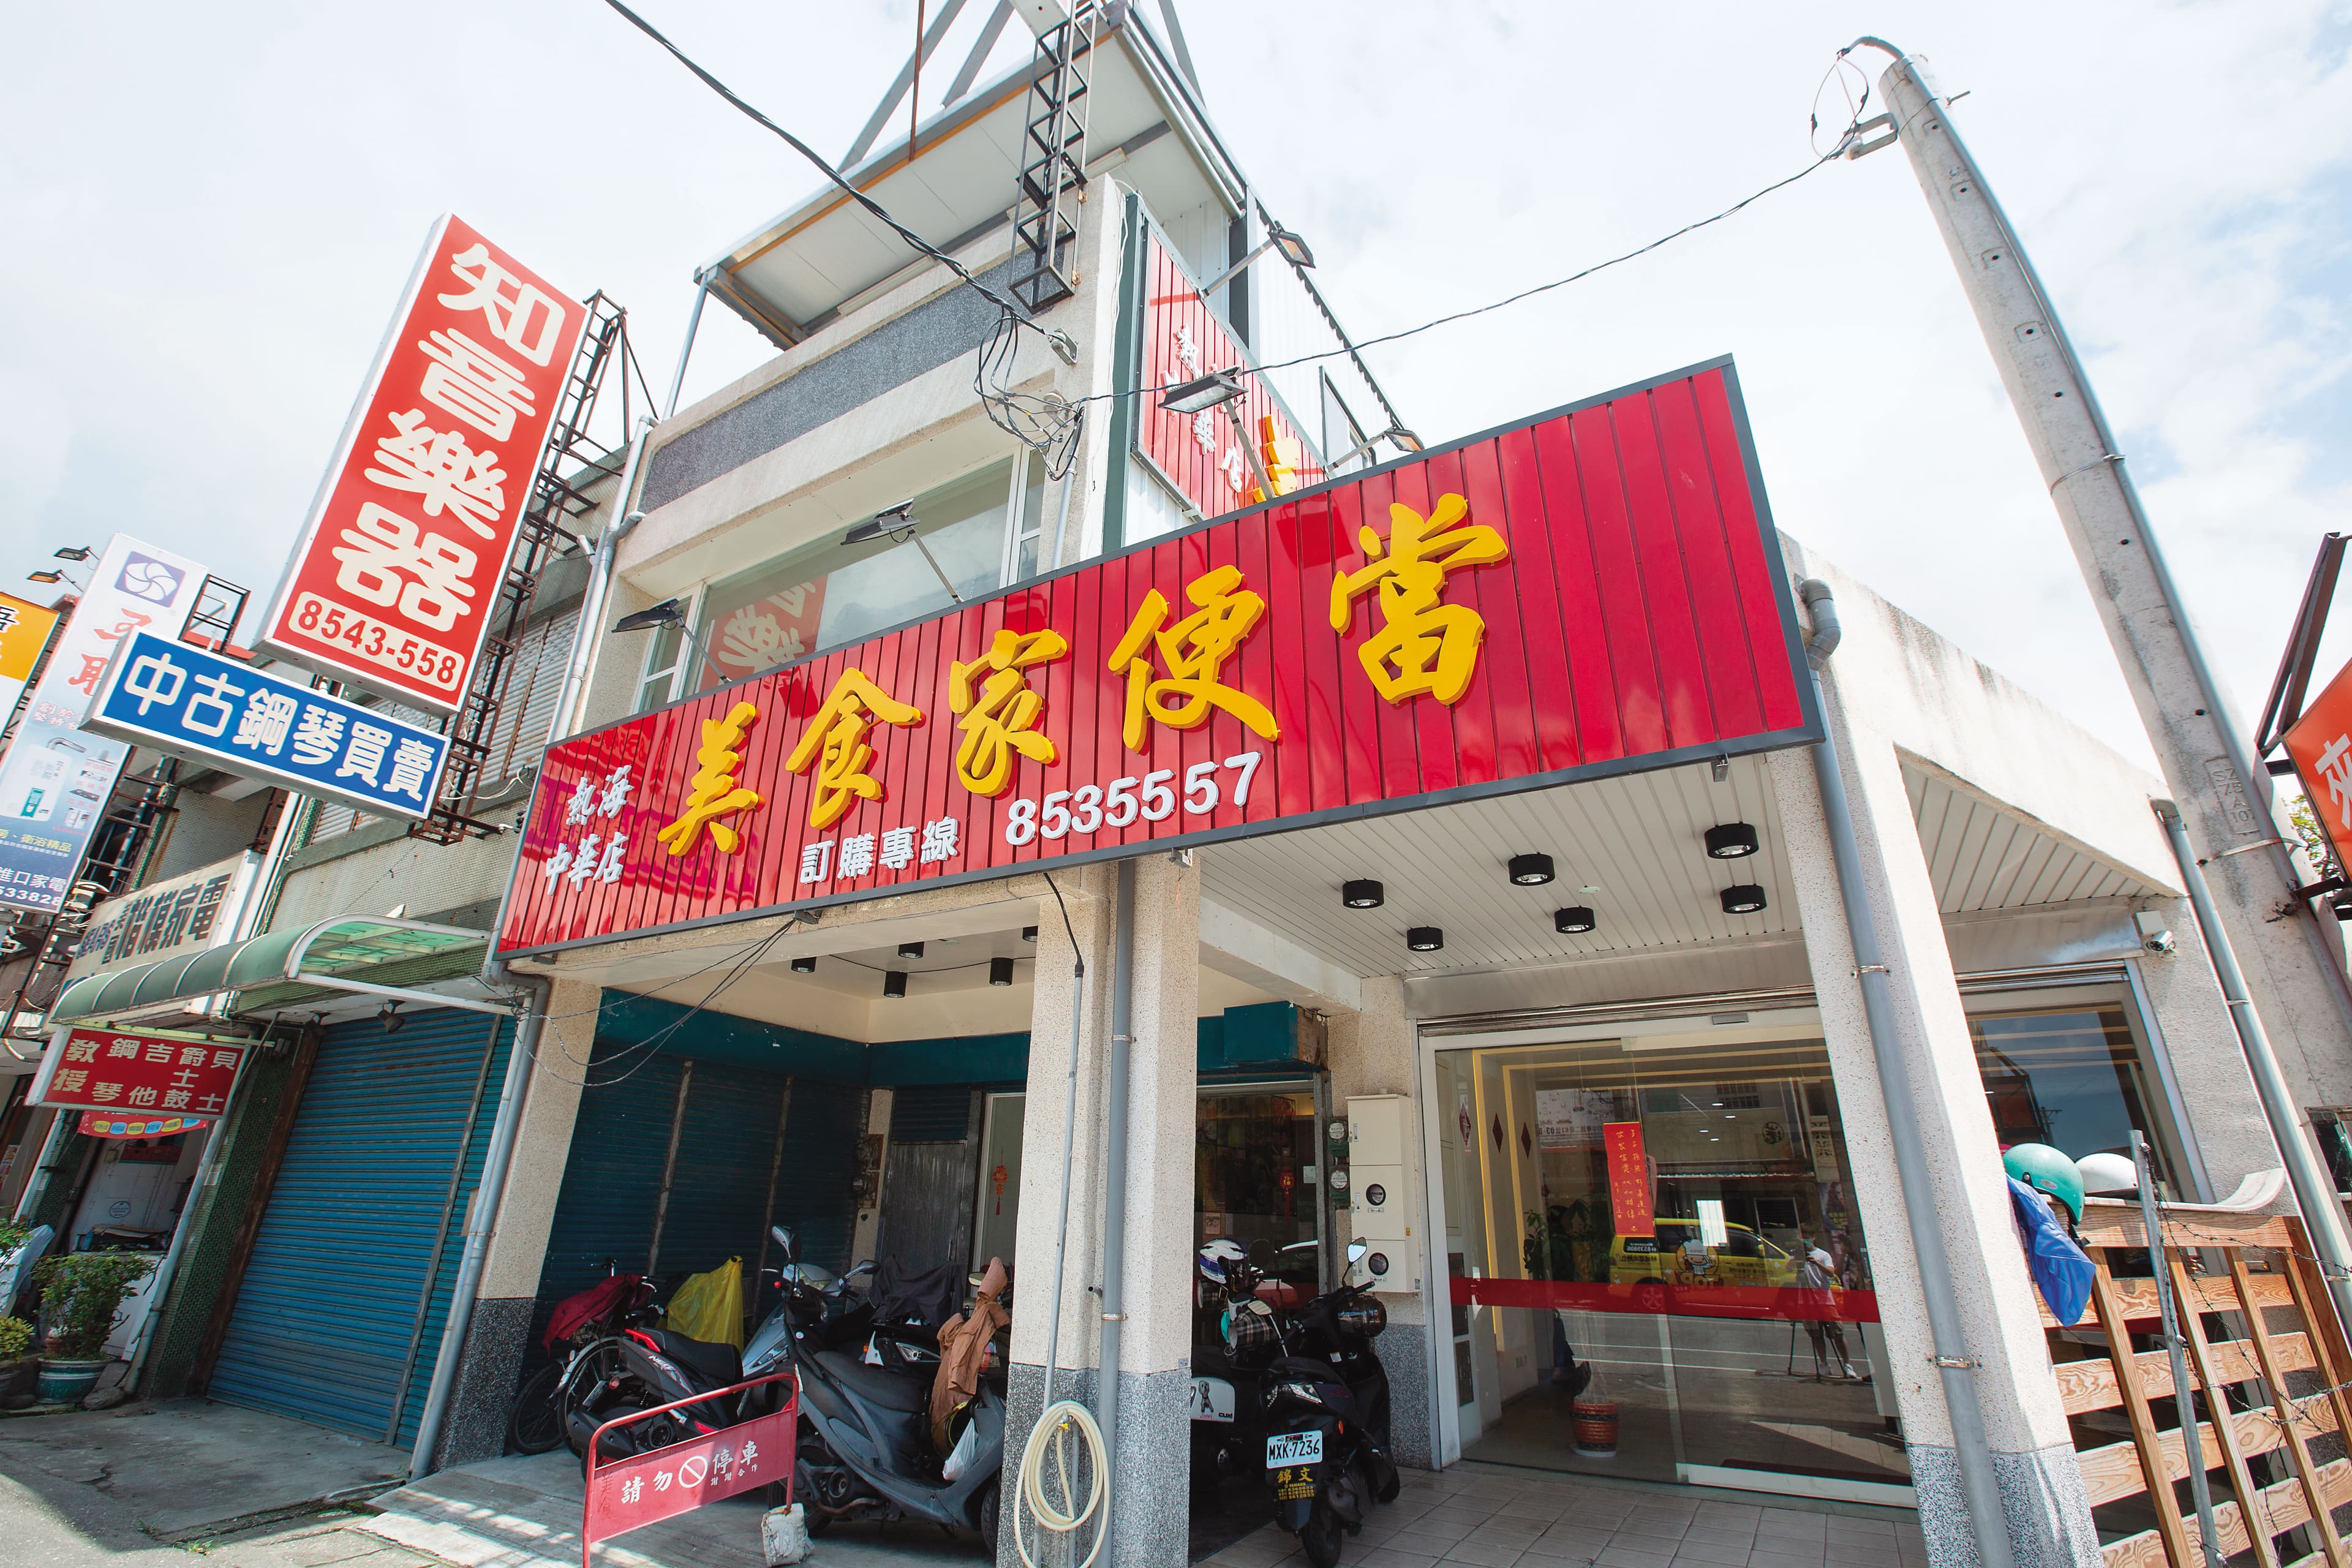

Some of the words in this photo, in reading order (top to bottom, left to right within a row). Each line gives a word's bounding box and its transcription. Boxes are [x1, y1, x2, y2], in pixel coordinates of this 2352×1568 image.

[332, 243, 565, 631] 知音樂器
[298, 600, 456, 684] 8543-558
[657, 492, 1509, 856] 美食家便當
[124, 653, 435, 802] 中古鋼琴買賣
[566, 764, 634, 826] 熱海
[1005, 750, 1262, 846] 8535557
[545, 832, 629, 895] 中華店
[800, 817, 959, 884] 訂購專線
[92, 1038, 141, 1102] 鋼琴
[128, 1043, 175, 1106] 吉他
[161, 1047, 208, 1110] 爵士鼓
[195, 1050, 238, 1112] 貝士
[621, 1470, 673, 1504] 請勿
[712, 1441, 758, 1475] 停車
